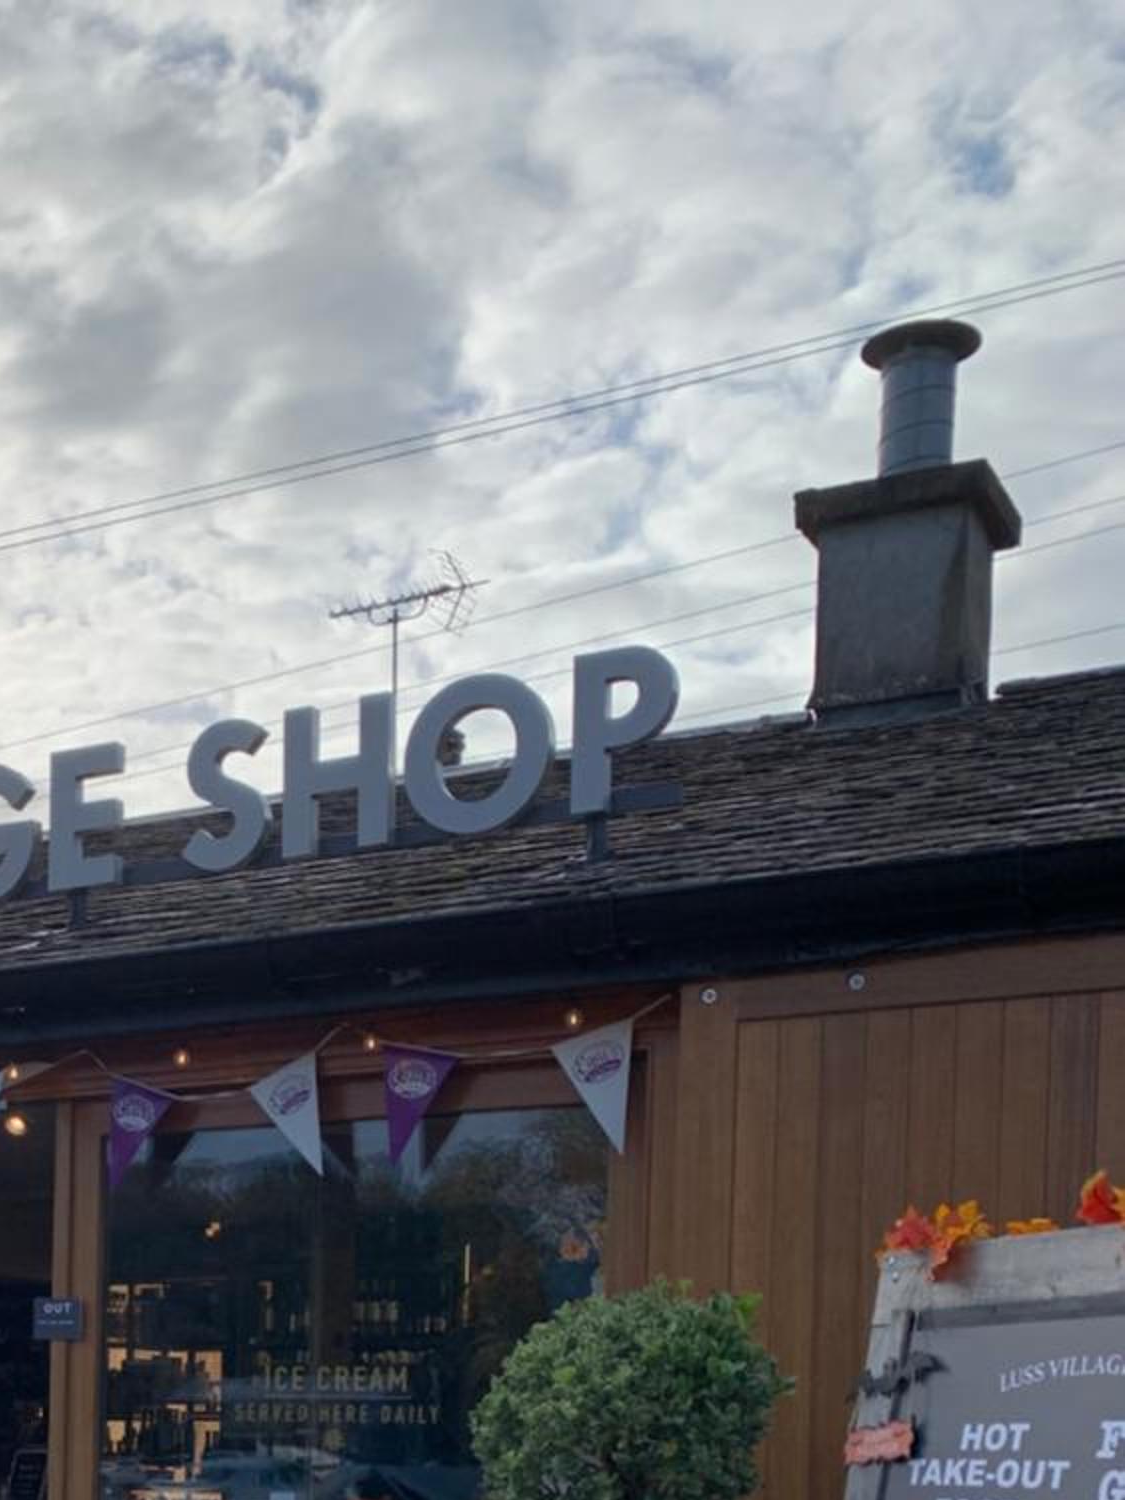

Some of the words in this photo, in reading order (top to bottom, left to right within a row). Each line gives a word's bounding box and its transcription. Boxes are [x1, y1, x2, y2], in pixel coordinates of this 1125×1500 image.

[181, 645, 679, 872] SHOP
[43, 1302, 74, 1314] OUT
[265, 1365, 305, 1392] ICE
[316, 1365, 409, 1392] CREAM
[999, 1361, 1046, 1393] LUSS
[1049, 1354, 1125, 1377] VILLAG
[235, 1403, 308, 1423] SERVED
[318, 1403, 370, 1424] HERE
[379, 1404, 441, 1425] DAILY
[960, 1423, 1031, 1451] HOT
[908, 1458, 1071, 1490] TAKE-OUT
